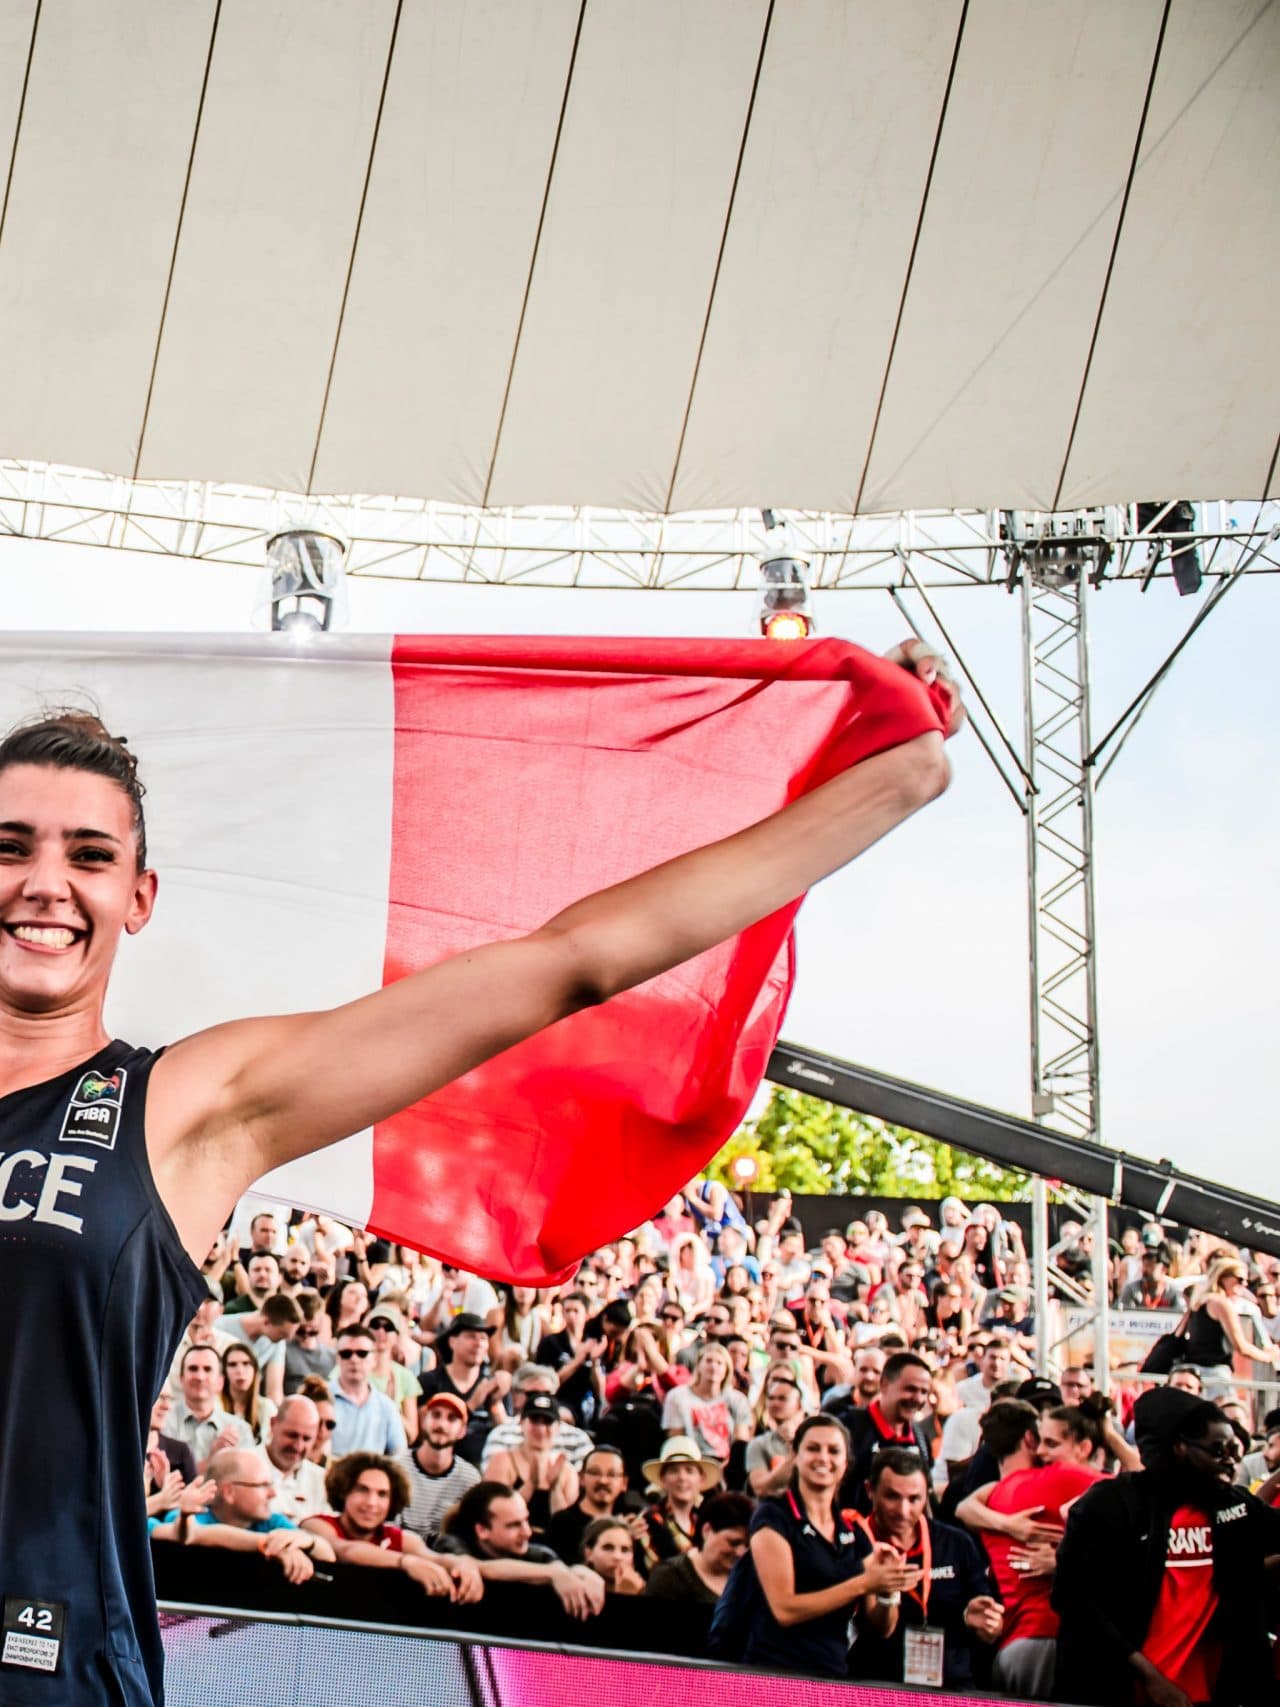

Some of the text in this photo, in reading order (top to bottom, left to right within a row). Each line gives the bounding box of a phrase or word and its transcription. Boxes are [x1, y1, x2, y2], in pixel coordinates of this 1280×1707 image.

[74, 1107, 111, 1124] FIBA
[1166, 1527, 1214, 1554] RANC
[17, 1606, 53, 1631] 42
